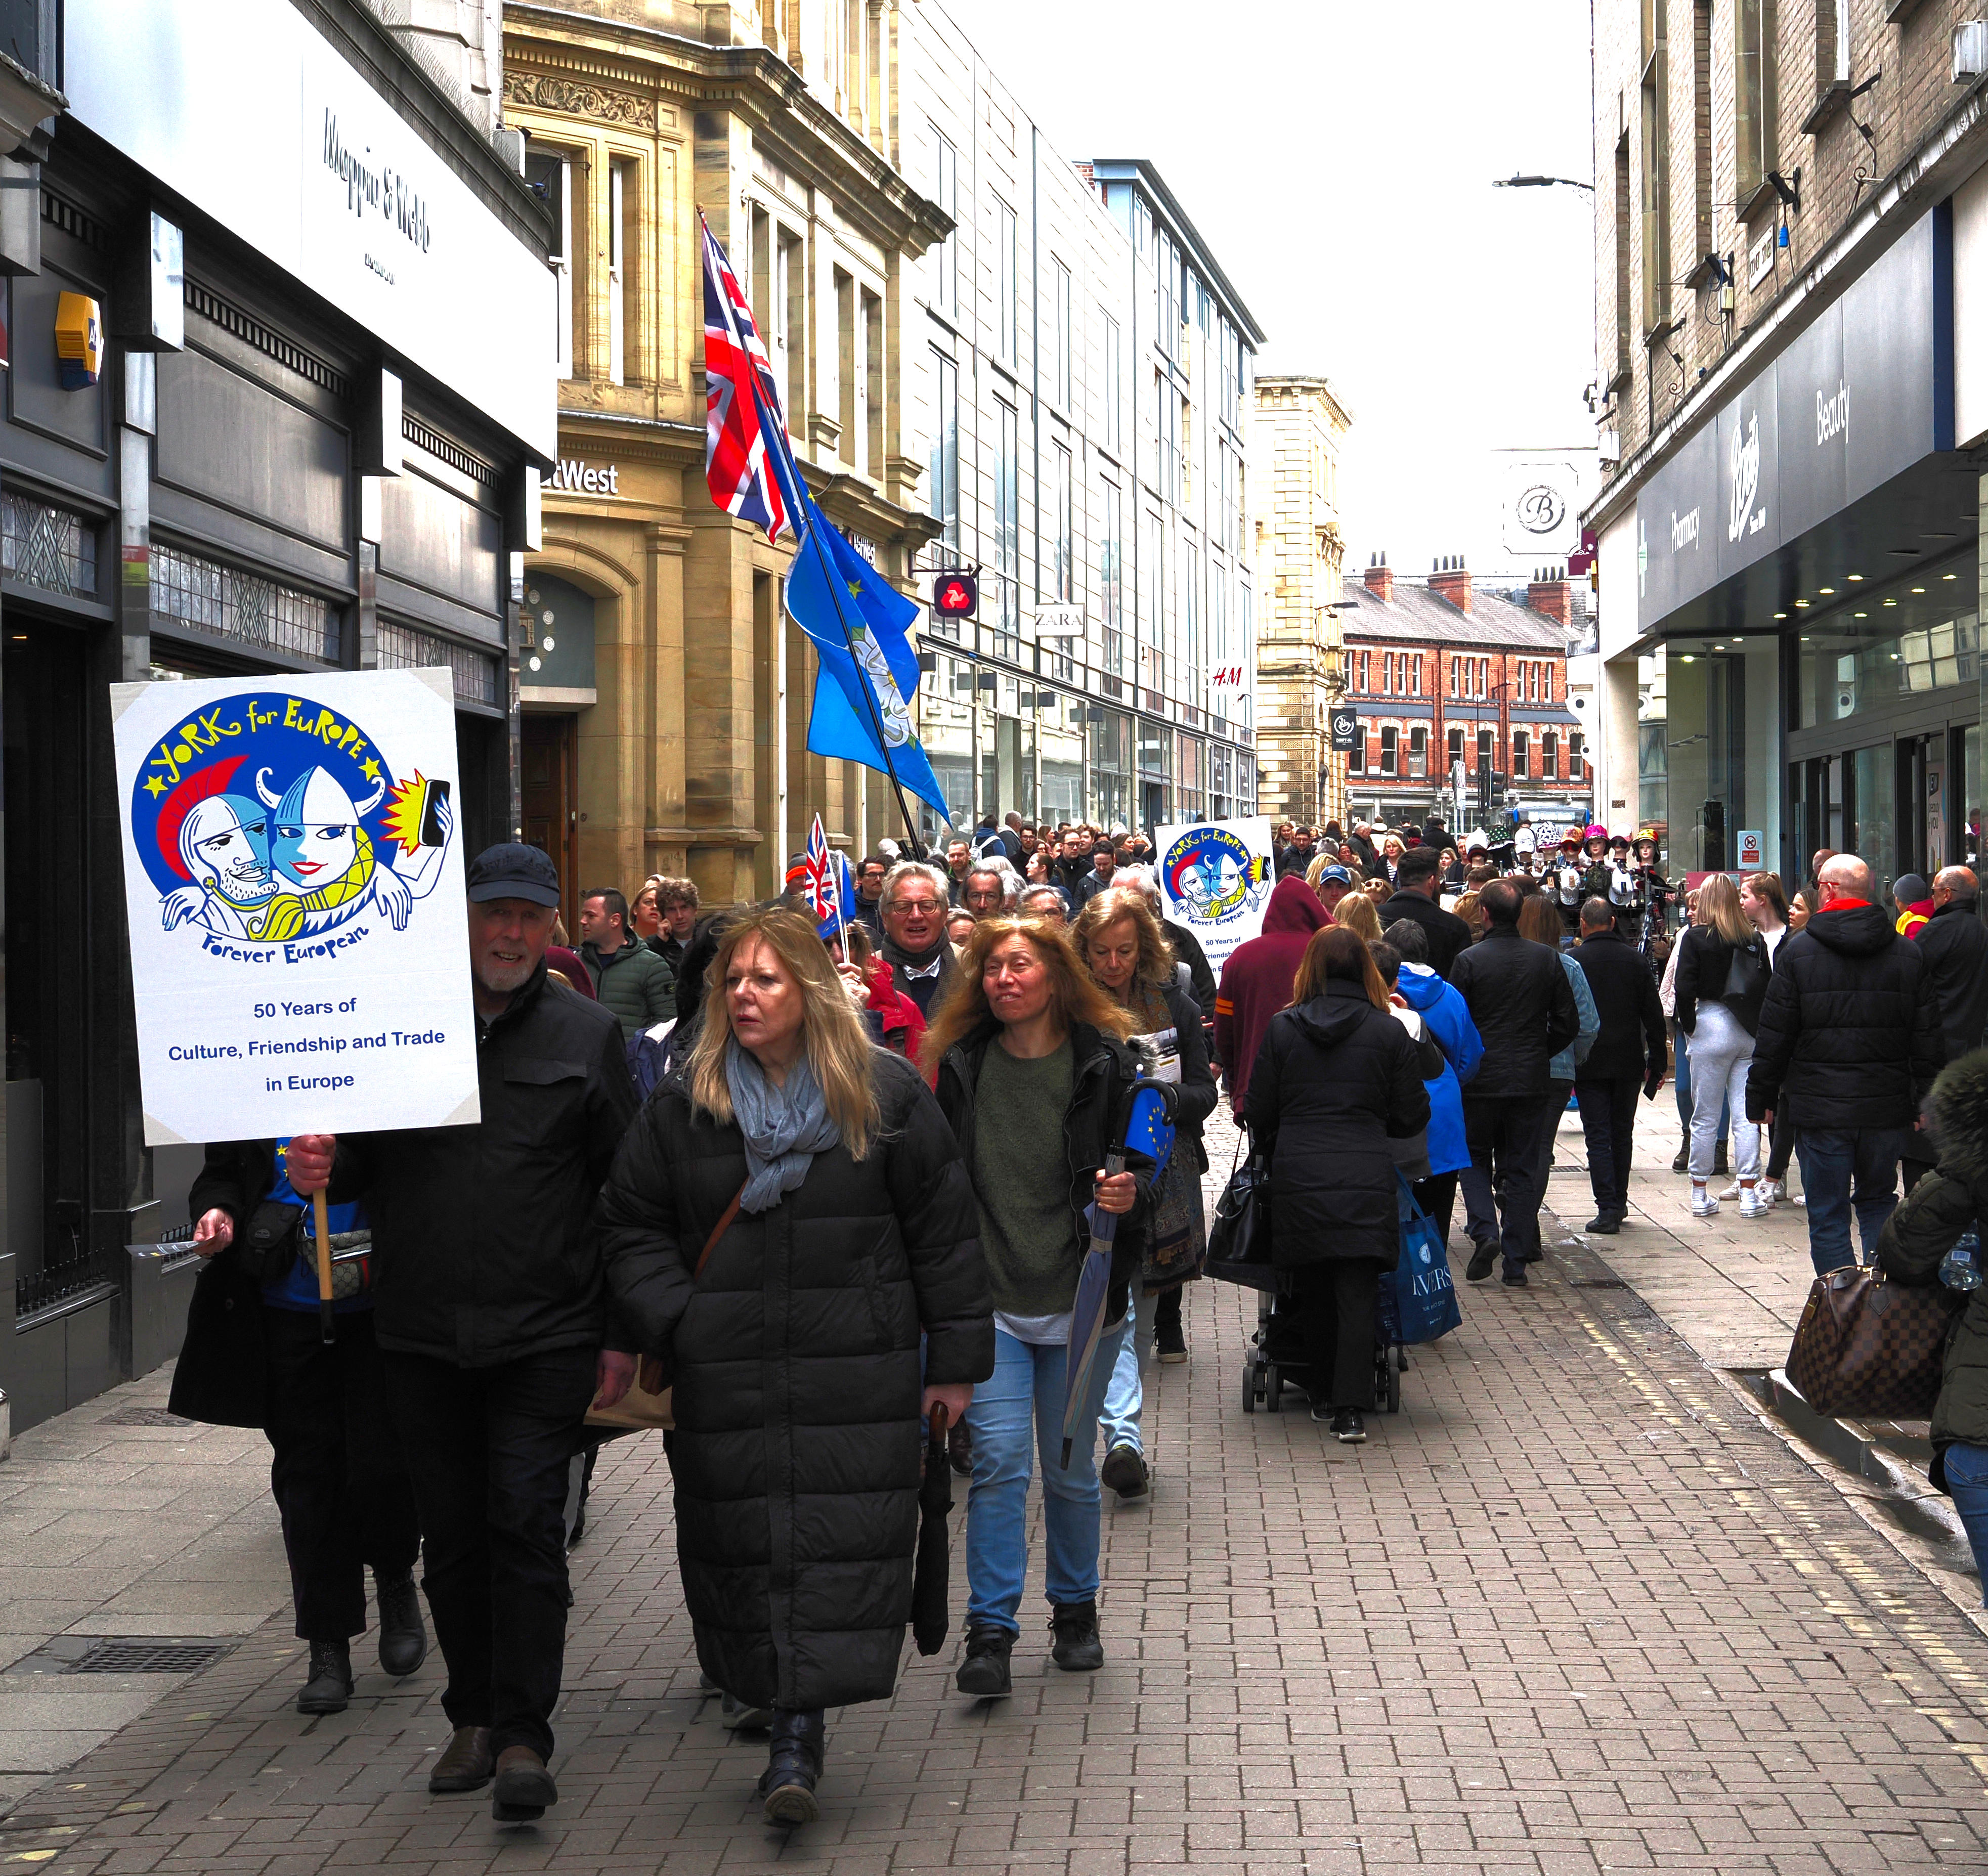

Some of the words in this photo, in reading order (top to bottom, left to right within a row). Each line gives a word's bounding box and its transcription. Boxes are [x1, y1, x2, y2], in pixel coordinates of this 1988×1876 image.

[1817, 379, 1850, 446] Beauty
[540, 459, 618, 494] tWest
[1671, 506, 1700, 554] Pharmacy
[1035, 613, 1084, 626] ZARA
[1213, 667, 1242, 686] H&M
[248, 701, 278, 732] for
[1200, 831, 1212, 843] for
[1187, 915, 1213, 926] Forever
[1215, 910, 1244, 926] European
[201, 932, 276, 963] Forever
[282, 926, 369, 965] European
[1204, 951, 1233, 959] Friendsh
[254, 1003, 276, 1018] 50
[280, 1001, 333, 1016] Years
[338, 997, 357, 1013] of
[168, 1044, 243, 1061] Culture,
[248, 1037, 347, 1056] Friendship
[352, 1032, 386, 1049] and
[391, 1029, 445, 1046] Trade
[266, 1077, 282, 1092] in
[287, 1074, 355, 1091] Europe
